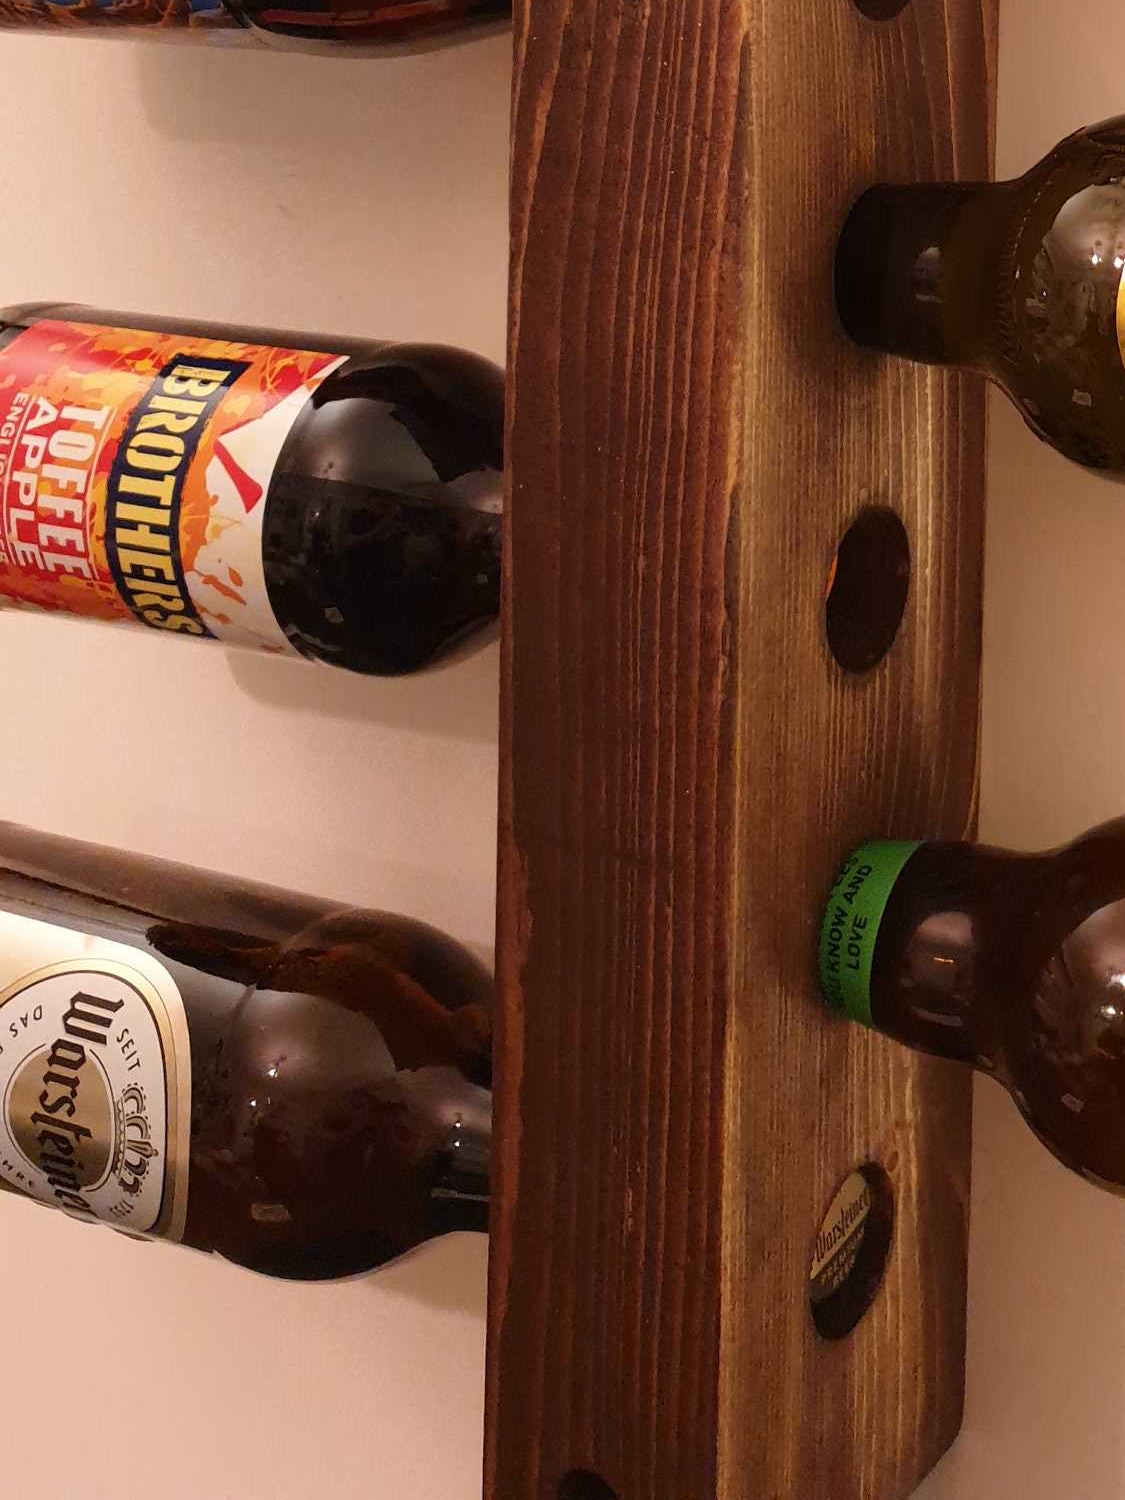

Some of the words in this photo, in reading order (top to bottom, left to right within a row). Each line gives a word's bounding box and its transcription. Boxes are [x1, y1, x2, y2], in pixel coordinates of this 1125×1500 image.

[9, 396, 59, 570] APPLE
[38, 404, 113, 580] TOFFEE
[115, 364, 231, 636] BROTHERS
[826, 906, 848, 972] KNOW
[843, 865, 872, 904] AND
[846, 914, 868, 970] LOVE
[10, 1005, 42, 1038] DAS
[117, 1028, 140, 1072] SEIT
